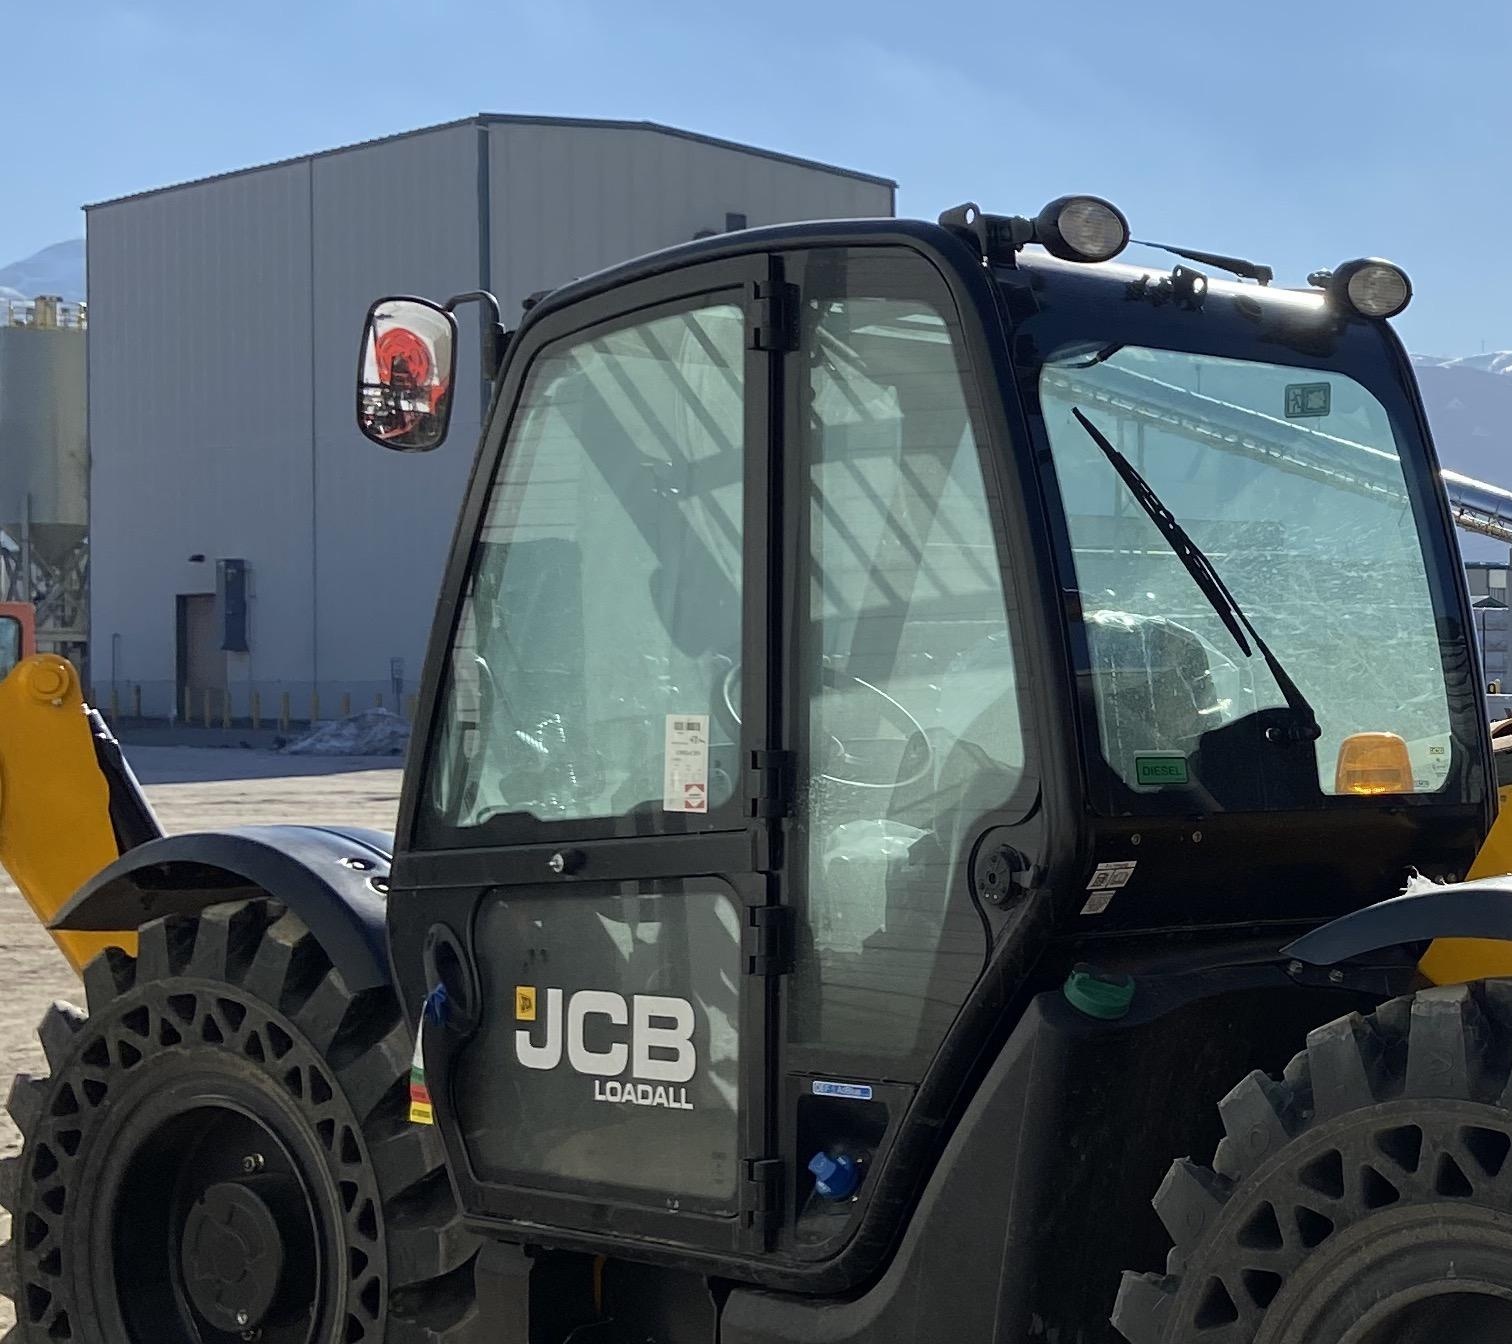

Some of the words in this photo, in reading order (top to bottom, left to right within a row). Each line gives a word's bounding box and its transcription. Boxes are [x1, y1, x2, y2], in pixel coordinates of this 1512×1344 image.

[1142, 765, 1184, 776] DIESEL
[515, 987, 696, 1083] JCB
[594, 1079, 694, 1110] LOADALL
